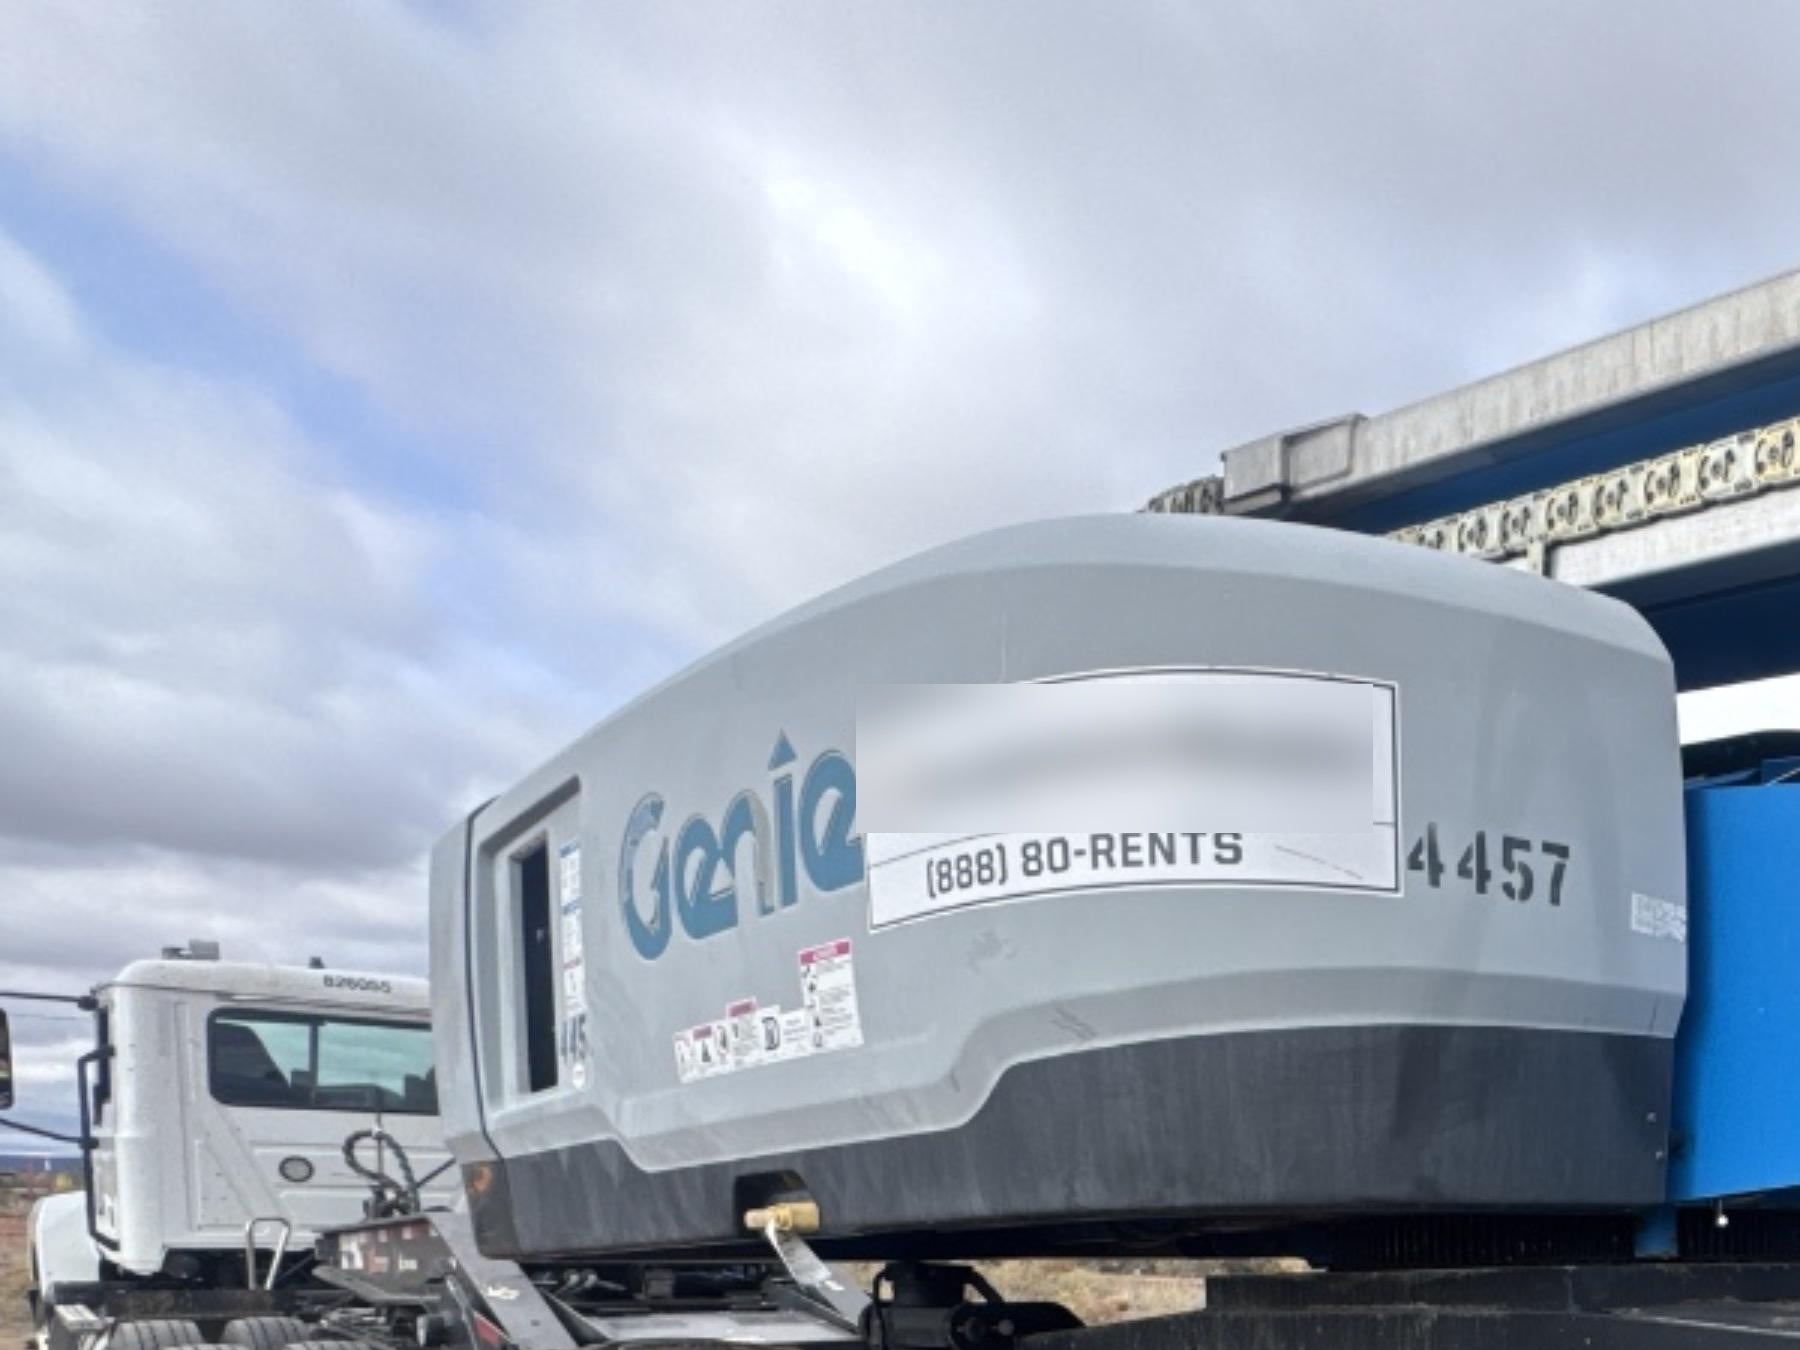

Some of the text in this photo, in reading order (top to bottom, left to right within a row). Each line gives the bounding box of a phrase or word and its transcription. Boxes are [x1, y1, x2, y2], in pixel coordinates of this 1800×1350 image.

[618, 728, 866, 961] Genie
[926, 832, 1244, 899] (888) 80-RENTS
[1406, 821, 1570, 907] 4457
